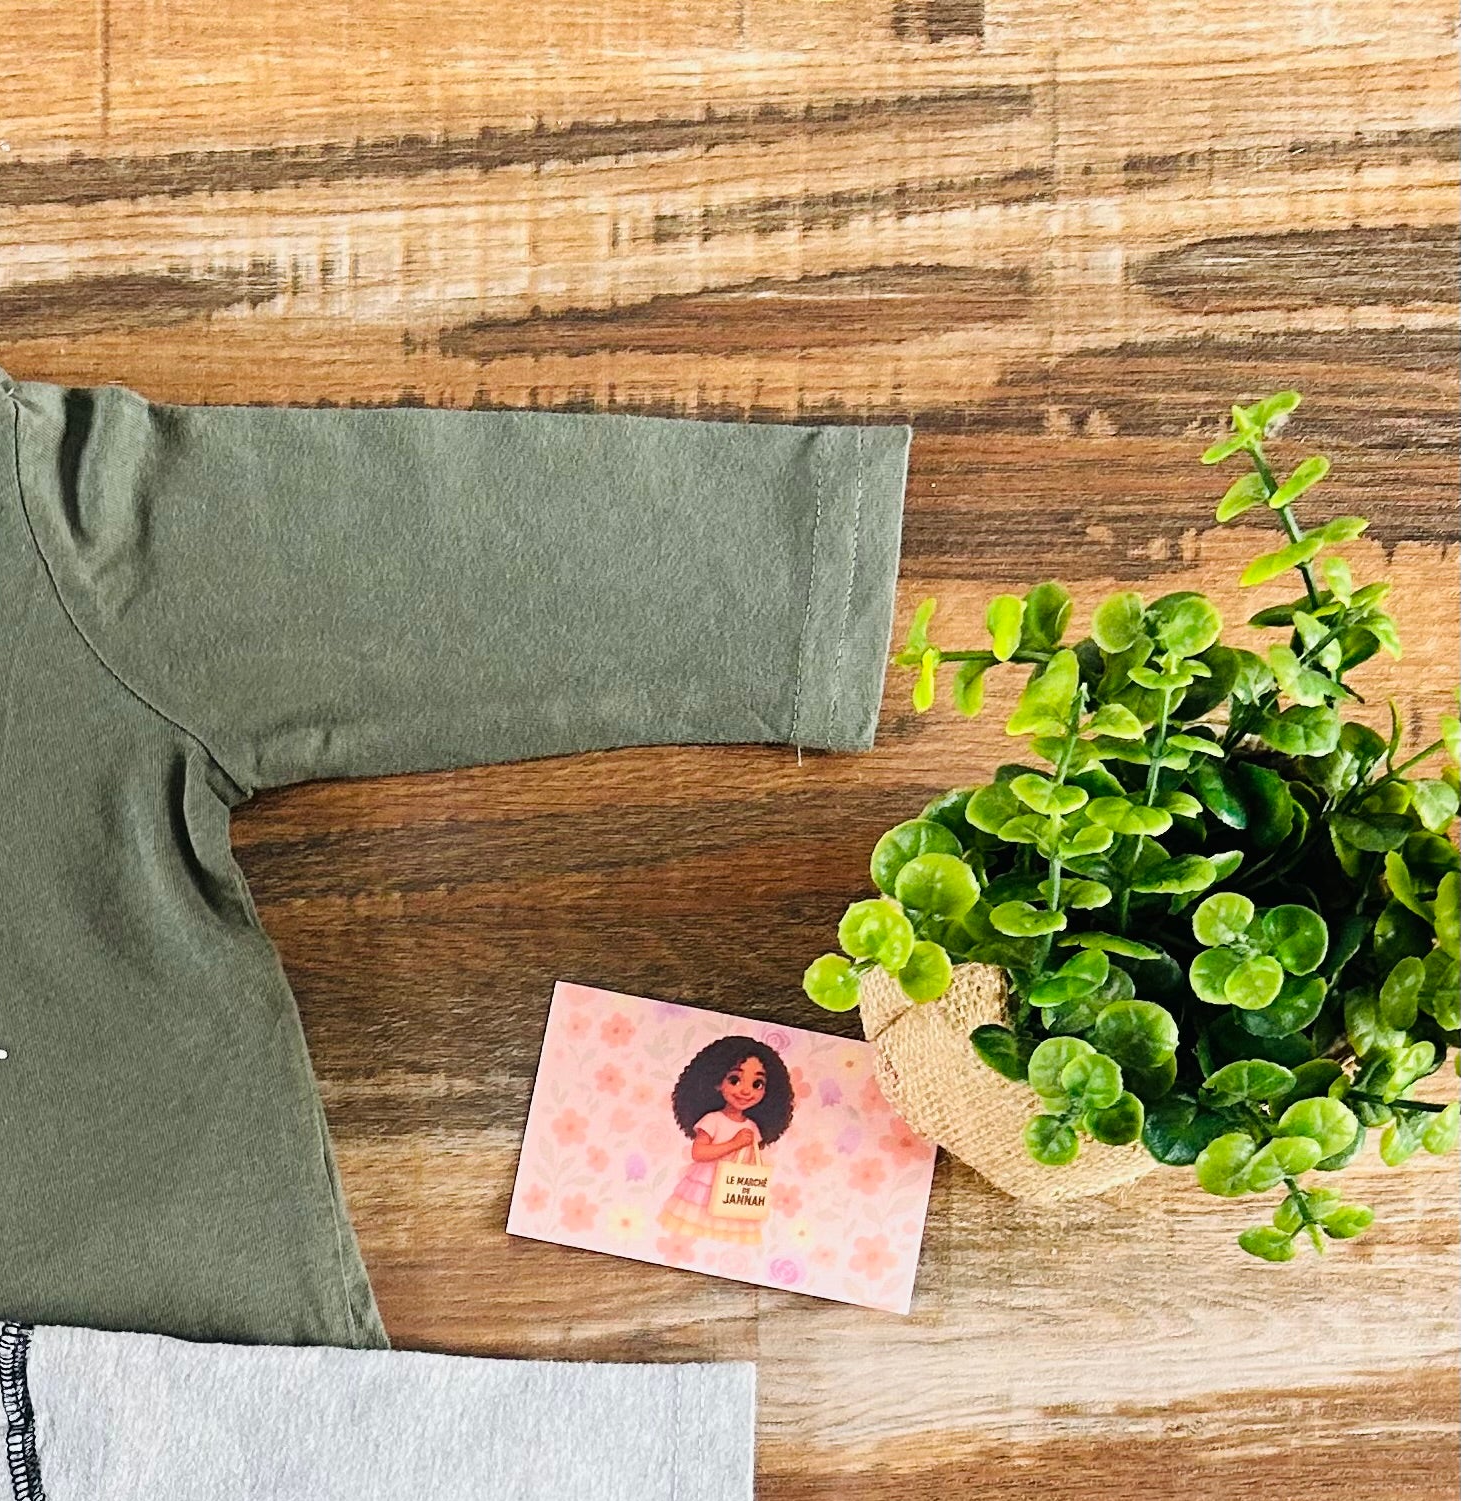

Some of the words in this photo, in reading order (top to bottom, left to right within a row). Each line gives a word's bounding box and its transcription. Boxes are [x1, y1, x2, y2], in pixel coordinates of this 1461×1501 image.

[726, 1176, 734, 1184] LE
[737, 1176, 768, 1188] MARCHÉ
[722, 1193, 766, 1206] JANNAH
